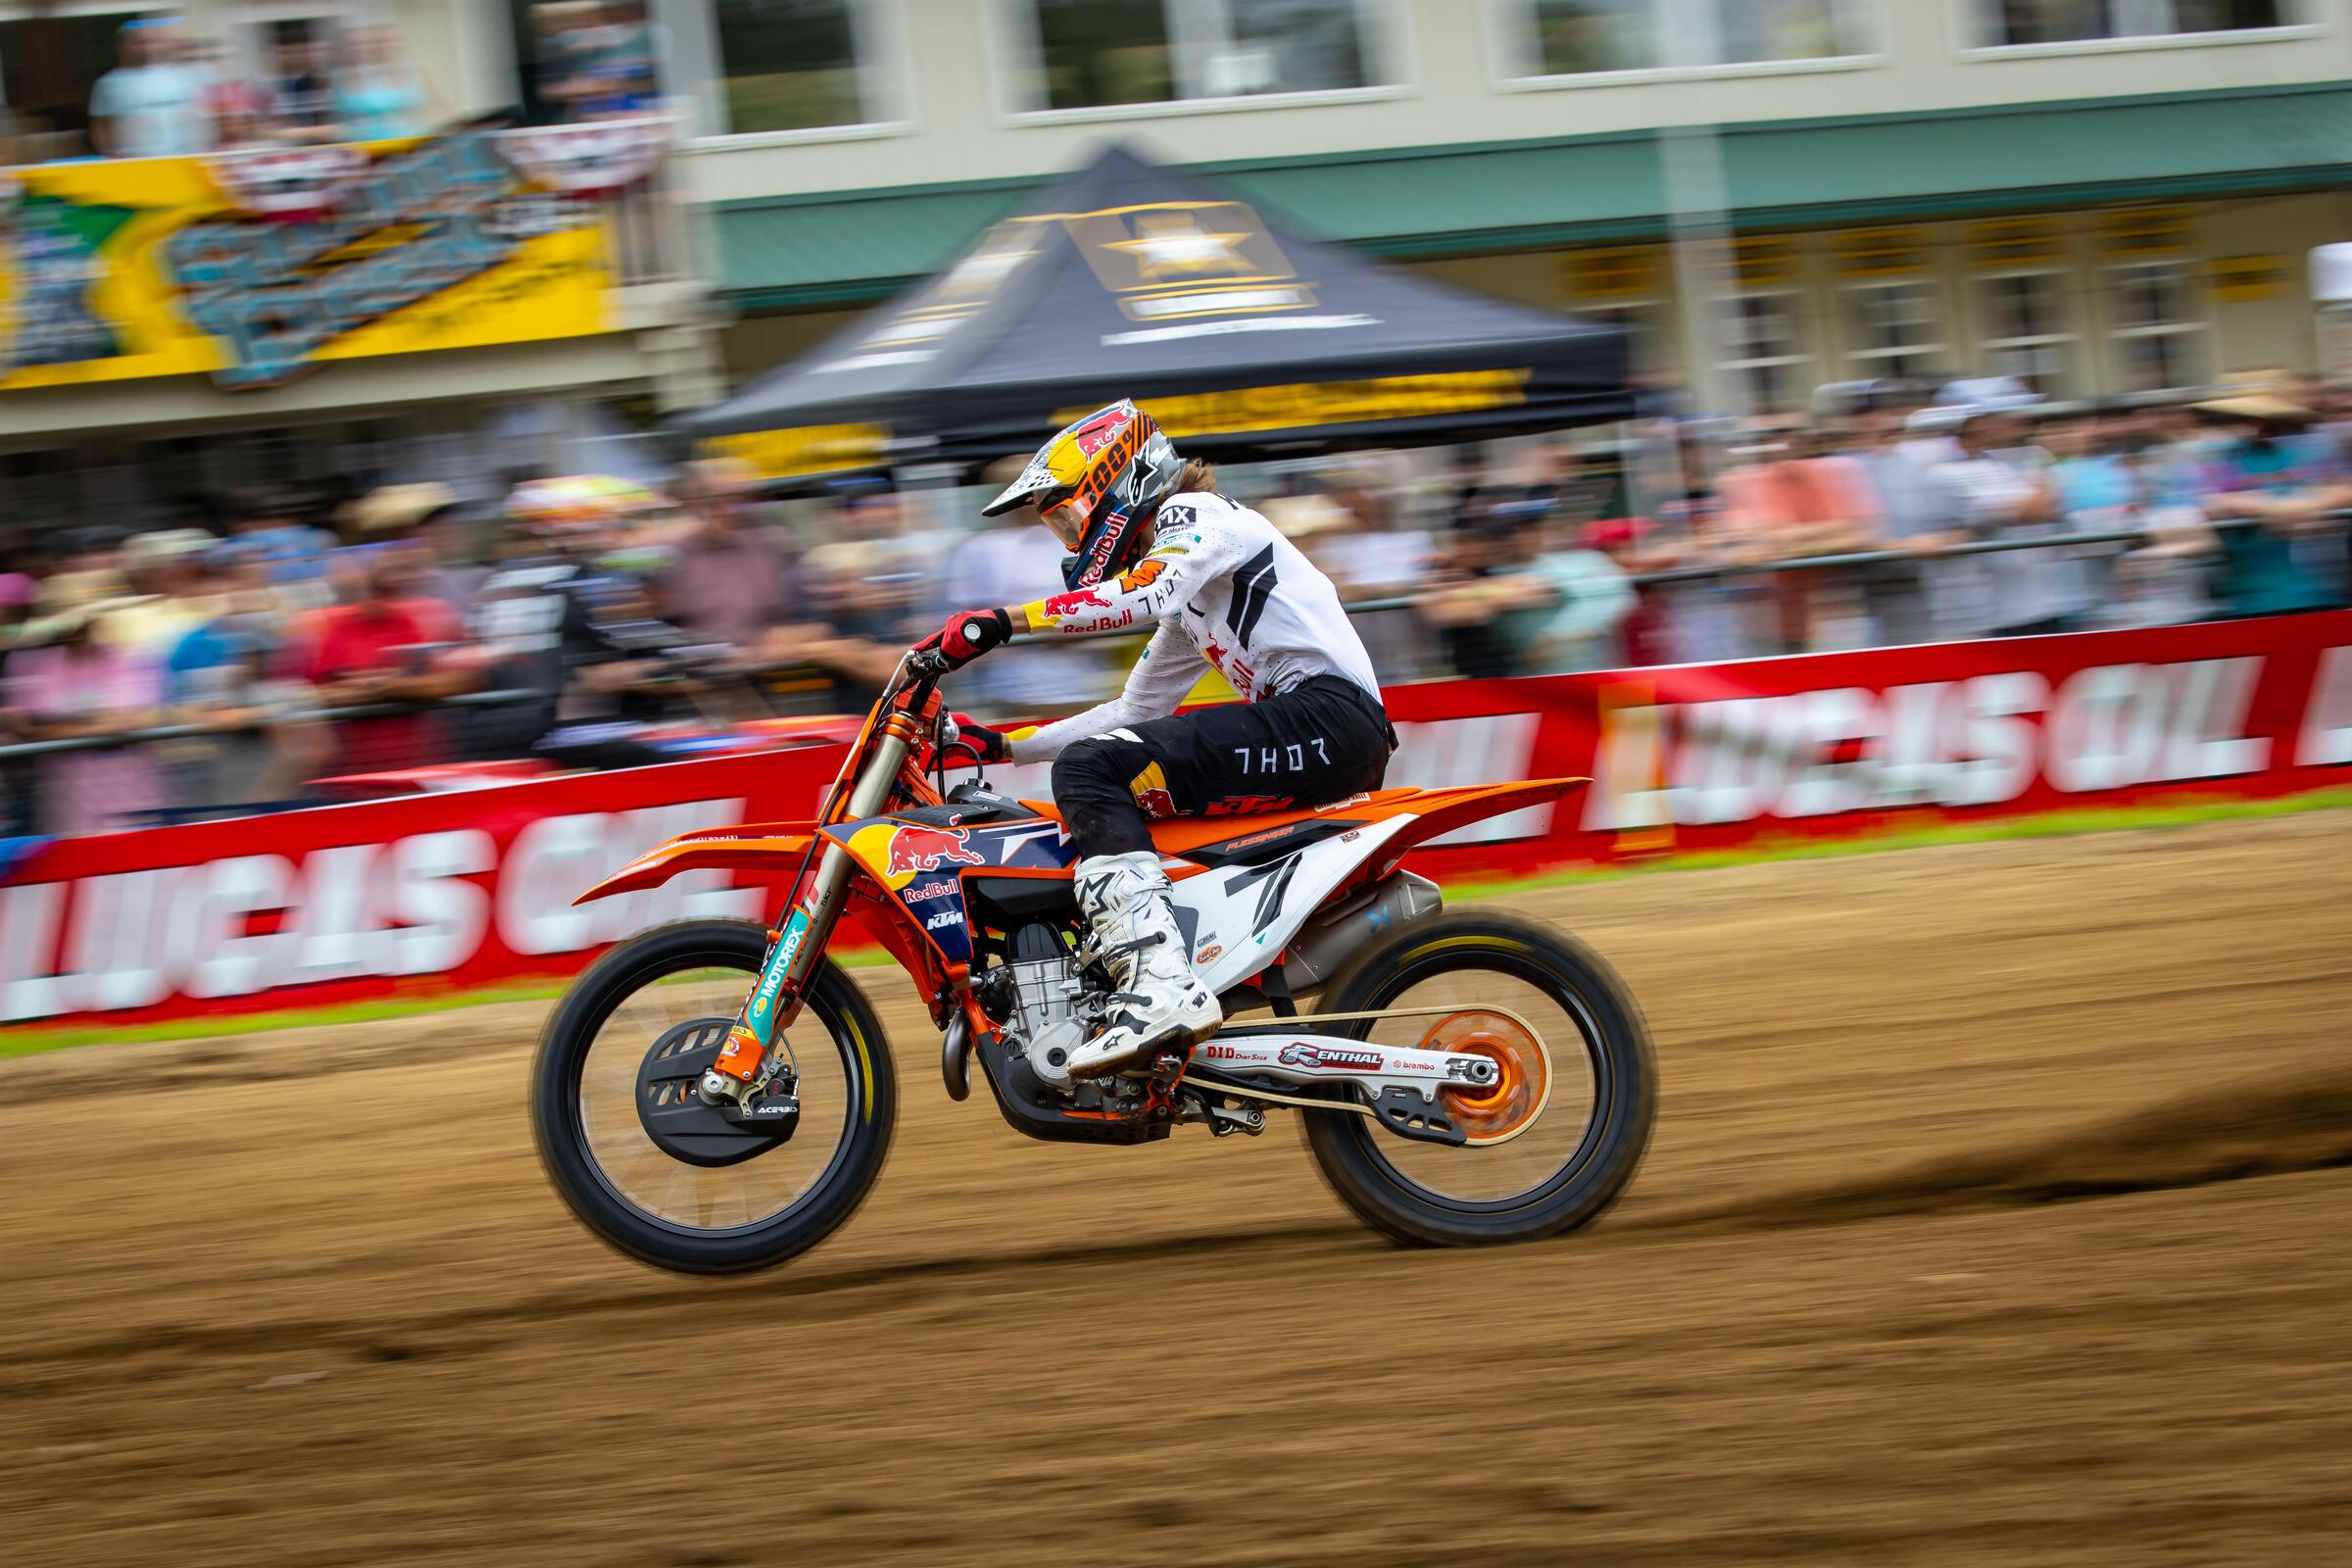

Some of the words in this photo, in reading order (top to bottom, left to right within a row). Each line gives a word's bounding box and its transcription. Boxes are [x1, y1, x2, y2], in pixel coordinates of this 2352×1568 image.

[1078, 548, 1108, 588] Red
[1095, 512, 1129, 554] Bull
[1063, 618, 1098, 633] Red
[1099, 609, 1133, 631] Bull
[1235, 738, 1331, 774] THOR
[1580, 671, 2052, 831] LUCAS
[2045, 655, 2274, 792] OIL
[1226, 826, 1295, 852] PLESSINGER
[904, 883, 933, 904] Red
[931, 879, 959, 897] Bull
[0, 828, 498, 1020] LUCAS
[927, 911, 963, 930] KTM
[760, 927, 806, 998] MOTOREX
[1281, 1044, 1382, 1066] RENTHAL
[1402, 1061, 1435, 1070] brembo
